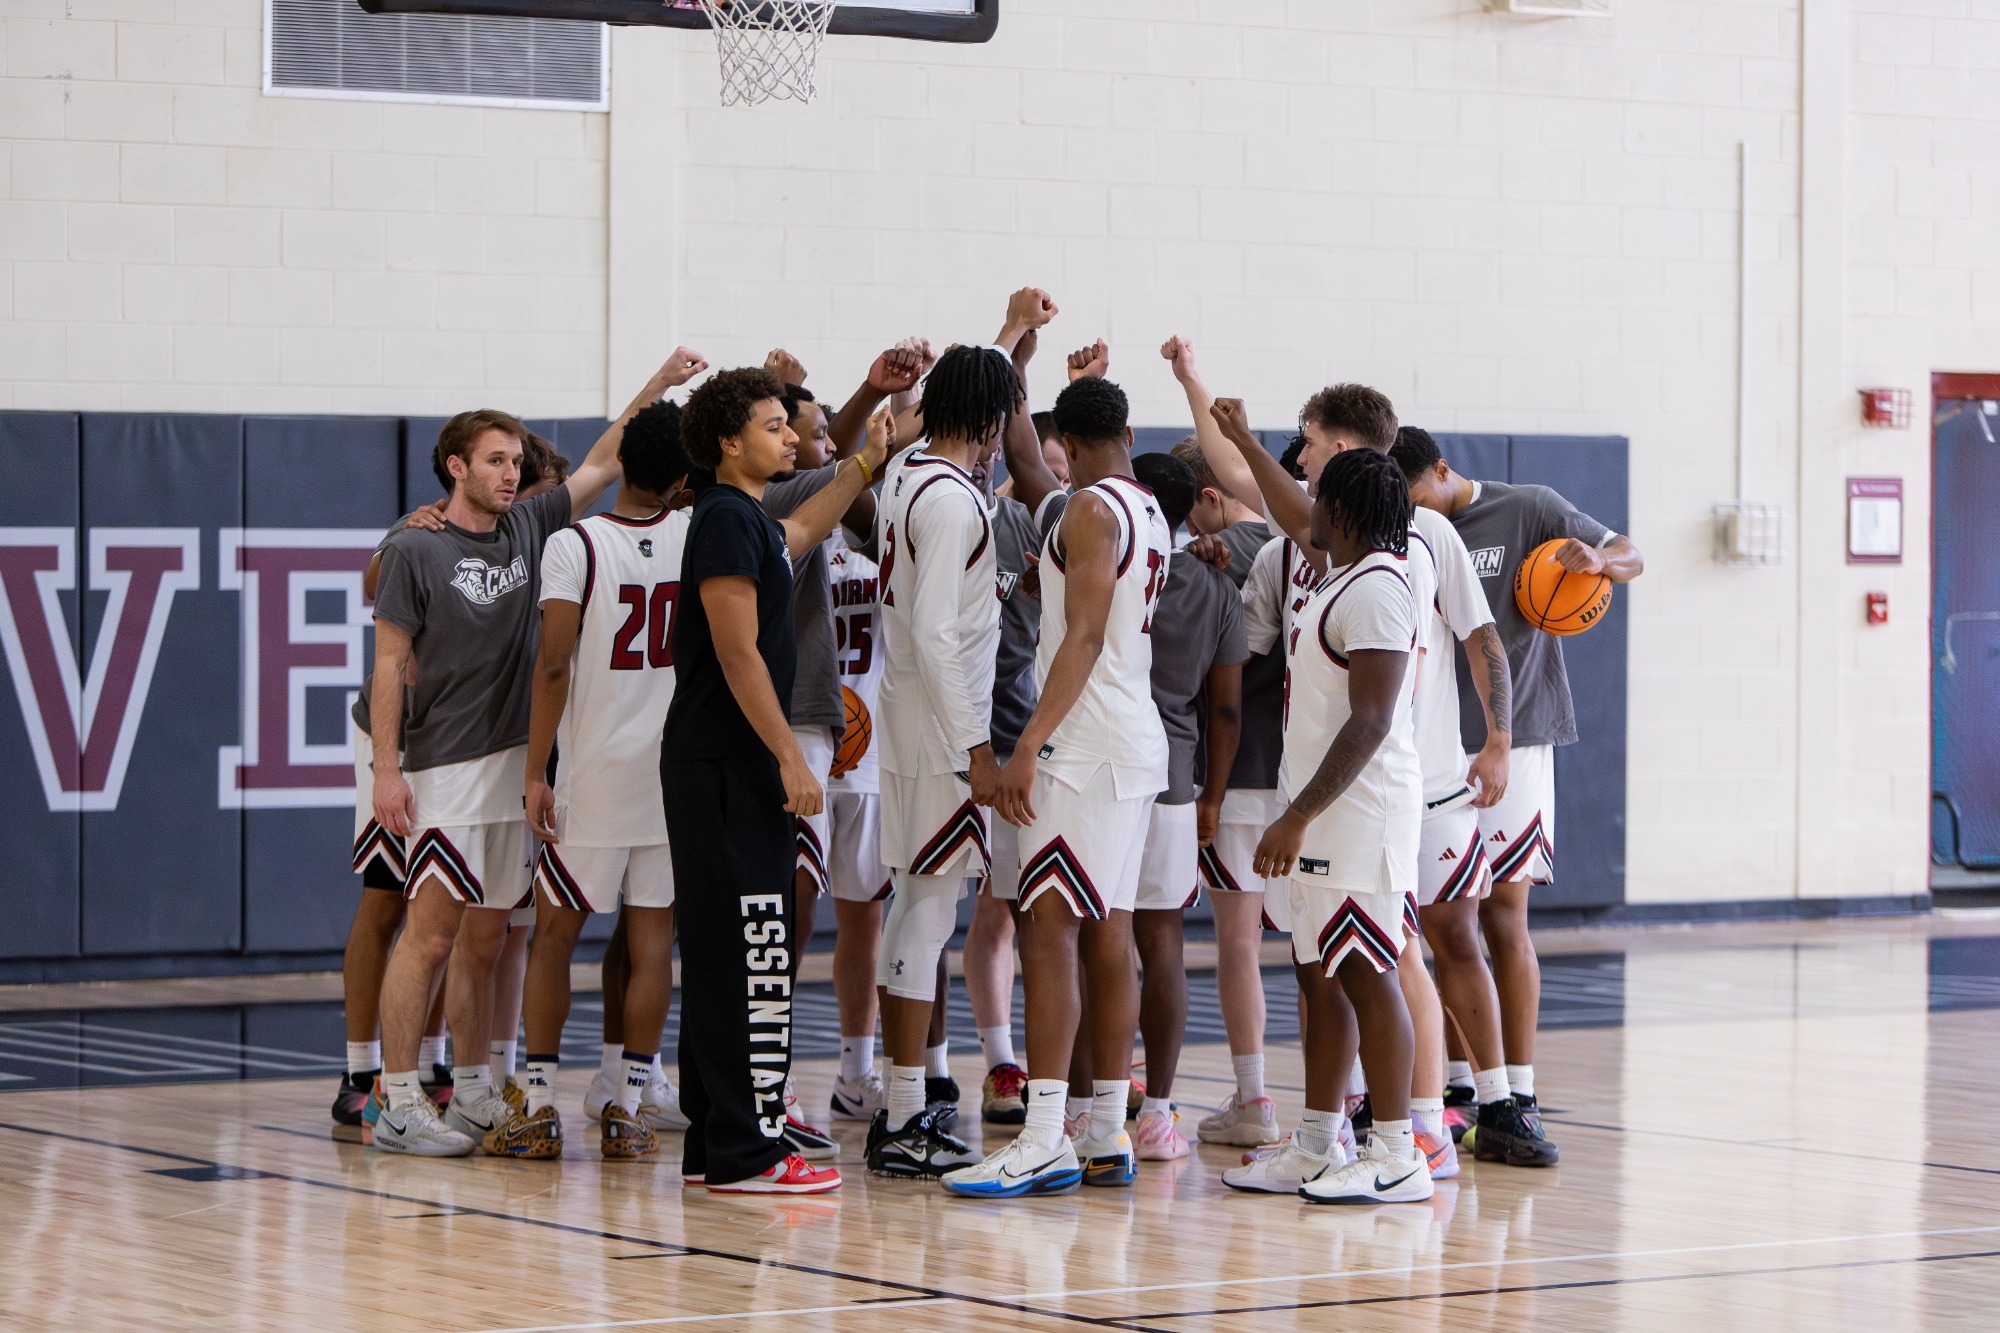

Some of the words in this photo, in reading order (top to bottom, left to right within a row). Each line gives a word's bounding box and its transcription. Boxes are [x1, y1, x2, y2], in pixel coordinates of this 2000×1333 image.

[609, 581, 681, 670] 20
[1578, 585, 1612, 624] Wils
[740, 894, 790, 1138] ESSENTIALS
